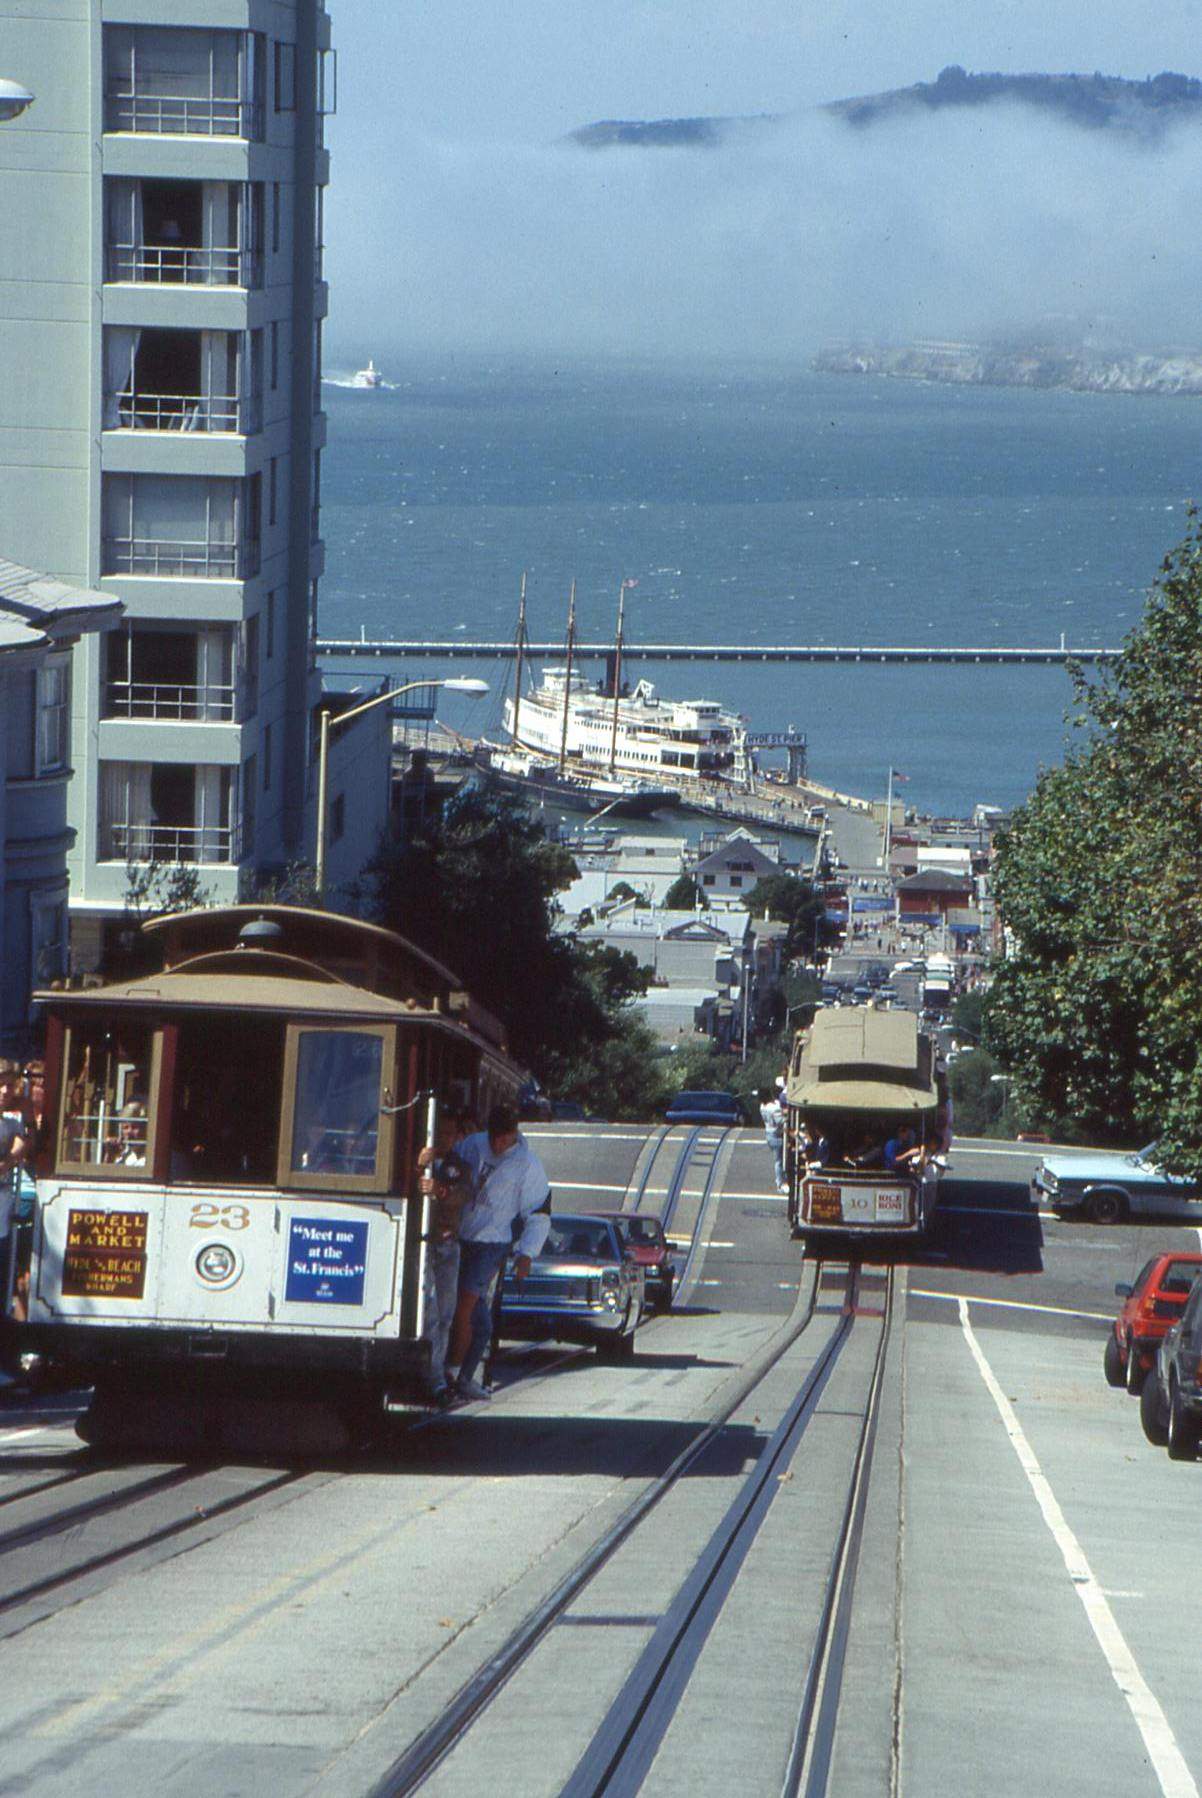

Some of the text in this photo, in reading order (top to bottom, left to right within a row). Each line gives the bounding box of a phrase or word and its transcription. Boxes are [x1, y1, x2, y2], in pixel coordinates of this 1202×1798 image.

[878, 1202, 902, 1210] RONI
[72, 1212, 145, 1227] POWELL
[189, 1203, 250, 1230] 23
[91, 1226, 127, 1236] AND
[336, 1231, 354, 1243] me
[69, 1233, 145, 1248] MARKET
[308, 1246, 343, 1259] at the
[108, 1258, 141, 1273] BEACH
[293, 1261, 310, 1274] St.
[73, 1272, 133, 1283] HERMANS
